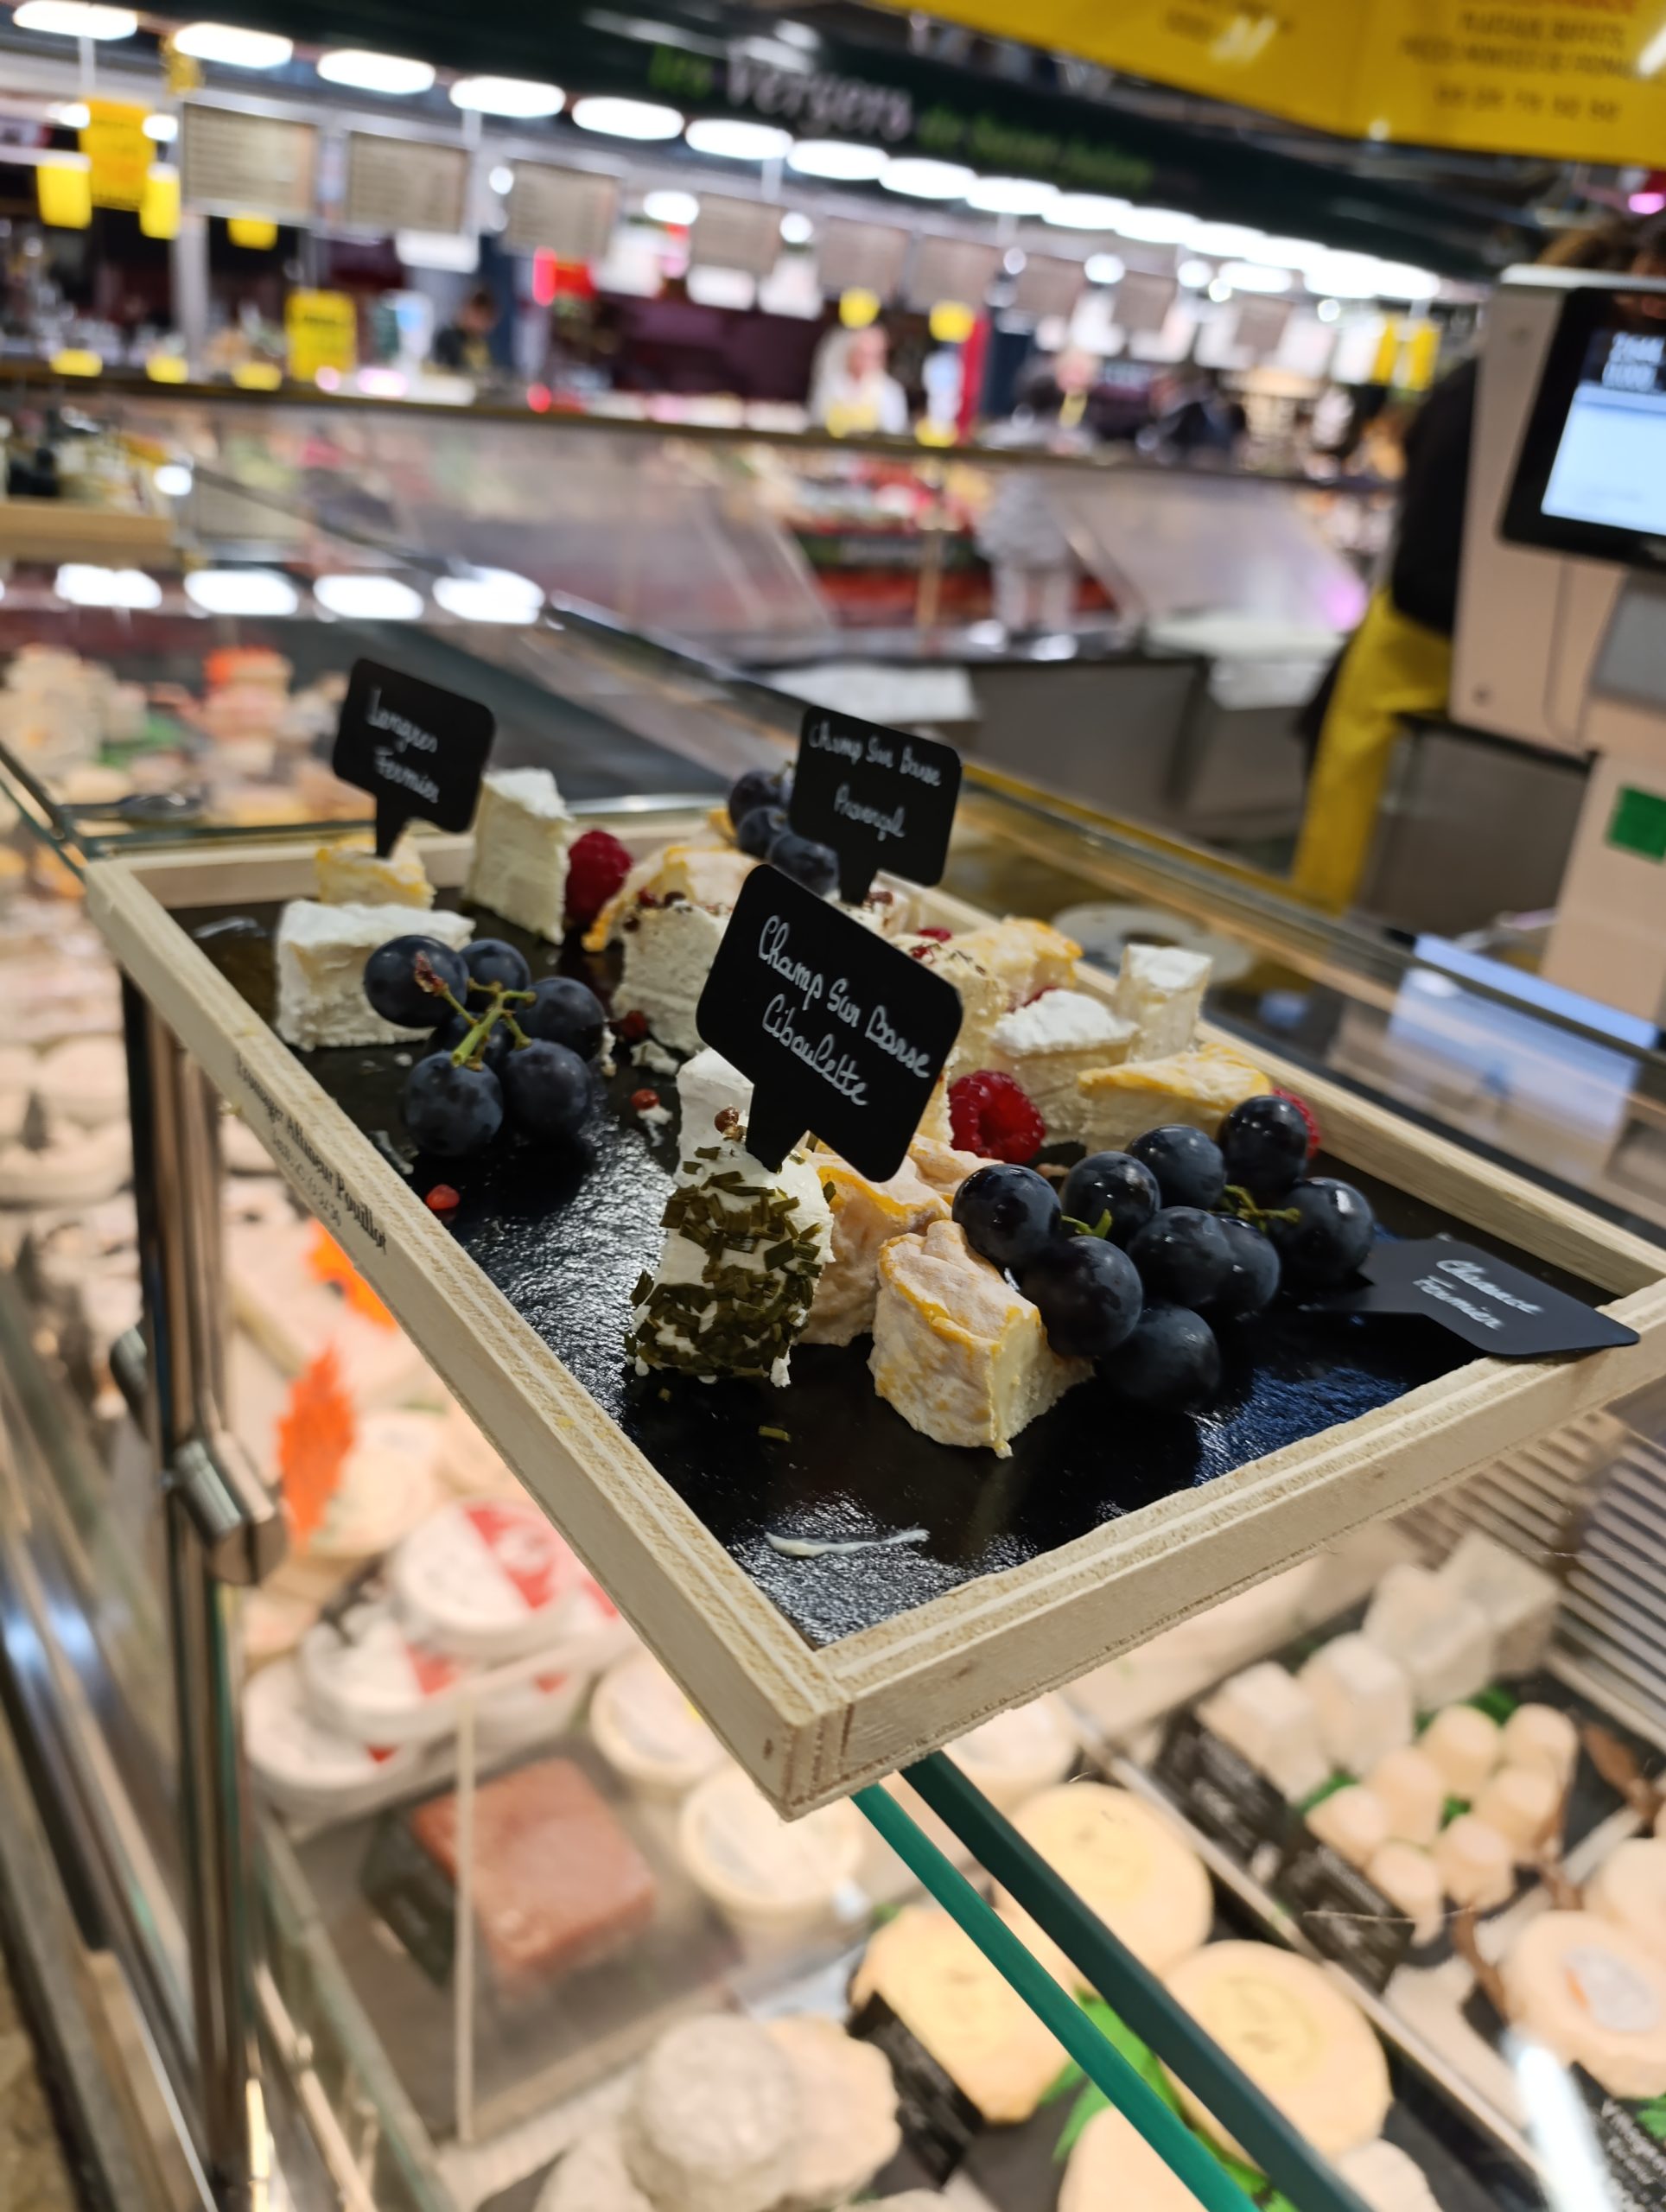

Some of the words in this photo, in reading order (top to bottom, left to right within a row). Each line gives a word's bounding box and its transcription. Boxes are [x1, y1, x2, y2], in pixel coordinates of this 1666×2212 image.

[758, 915, 823, 1011] Champ
[827, 978, 861, 1028] Sur
[762, 994, 869, 1106] Ciboulette
